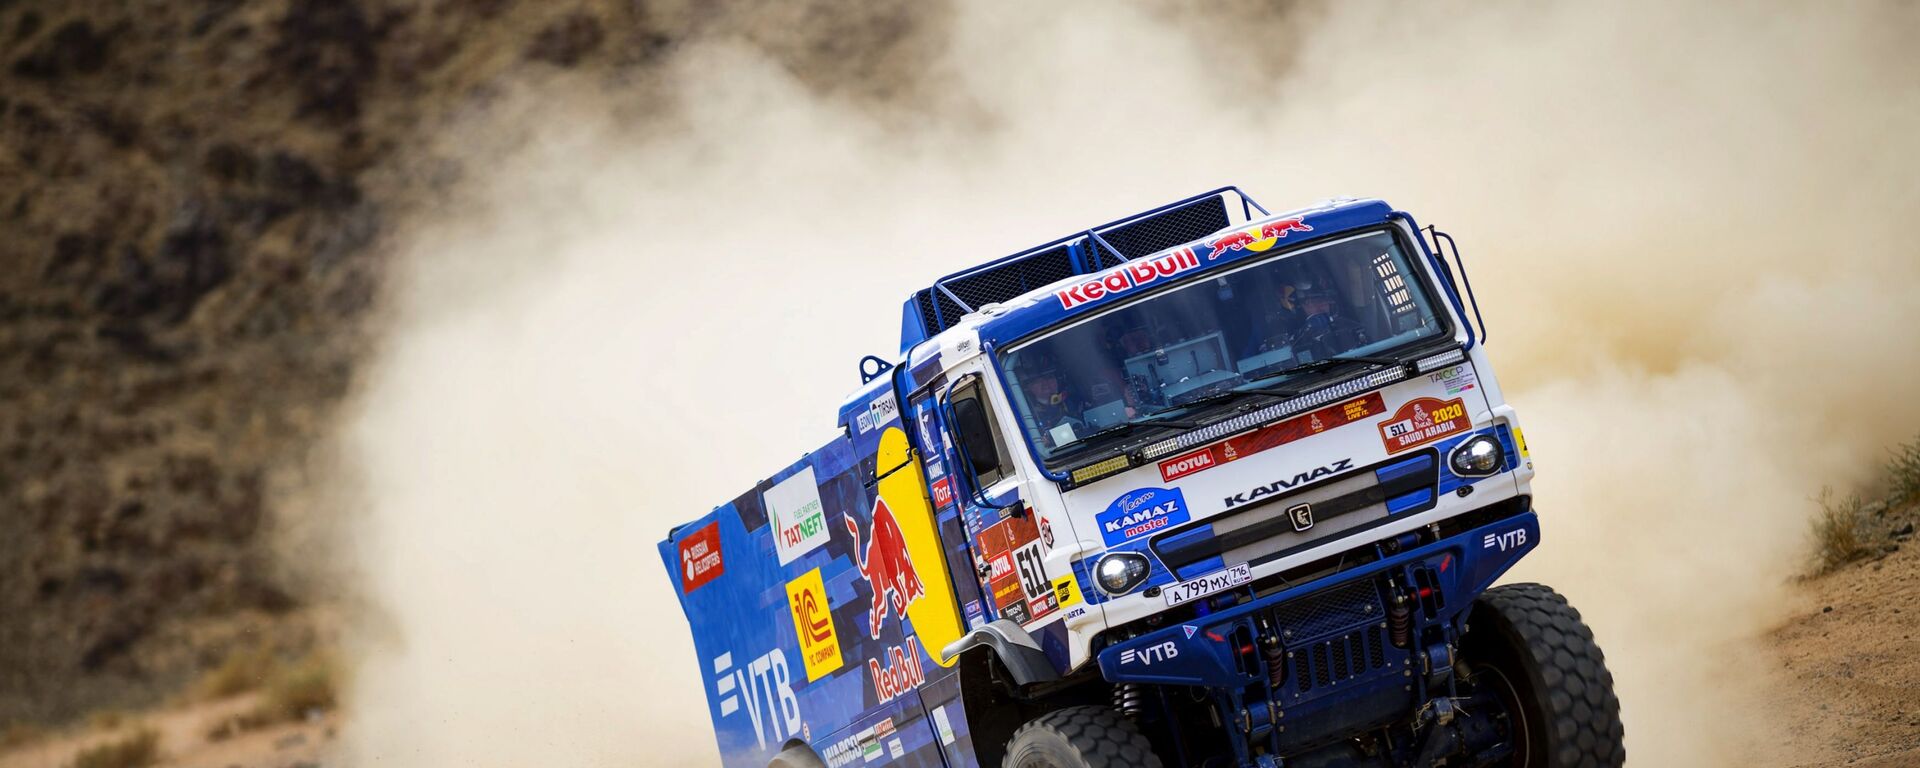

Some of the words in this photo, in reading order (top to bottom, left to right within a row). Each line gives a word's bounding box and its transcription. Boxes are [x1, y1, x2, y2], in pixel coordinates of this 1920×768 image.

[1058, 270, 1130, 309] Red
[1129, 247, 1200, 285] Bull
[1432, 403, 1463, 424] 2020
[1390, 423, 1407, 437] 511
[1399, 431, 1425, 446] SAUDI
[1426, 420, 1456, 438] ARABIA
[1167, 454, 1211, 477] MOTUL
[933, 484, 951, 502] TOTA
[1224, 458, 1354, 508] KAMAZ
[1118, 490, 1154, 513] Team
[1105, 501, 1179, 533] KAMAZ
[1125, 516, 1168, 537] master
[784, 512, 823, 548] TATNEFT
[1496, 528, 1526, 551] VTB
[690, 540, 709, 560] RUSSIAN
[694, 551, 720, 576] HELICOPTERS
[1016, 544, 1053, 599] 511
[1173, 589, 1183, 603] A
[1181, 578, 1208, 599] 799
[1210, 574, 1230, 592] MX
[1230, 566, 1247, 578] 716
[815, 644, 835, 665] COMPANY
[1136, 641, 1178, 665] VTB
[869, 647, 902, 704] Red
[894, 635, 925, 693] Bull
[736, 648, 801, 751] VTB
